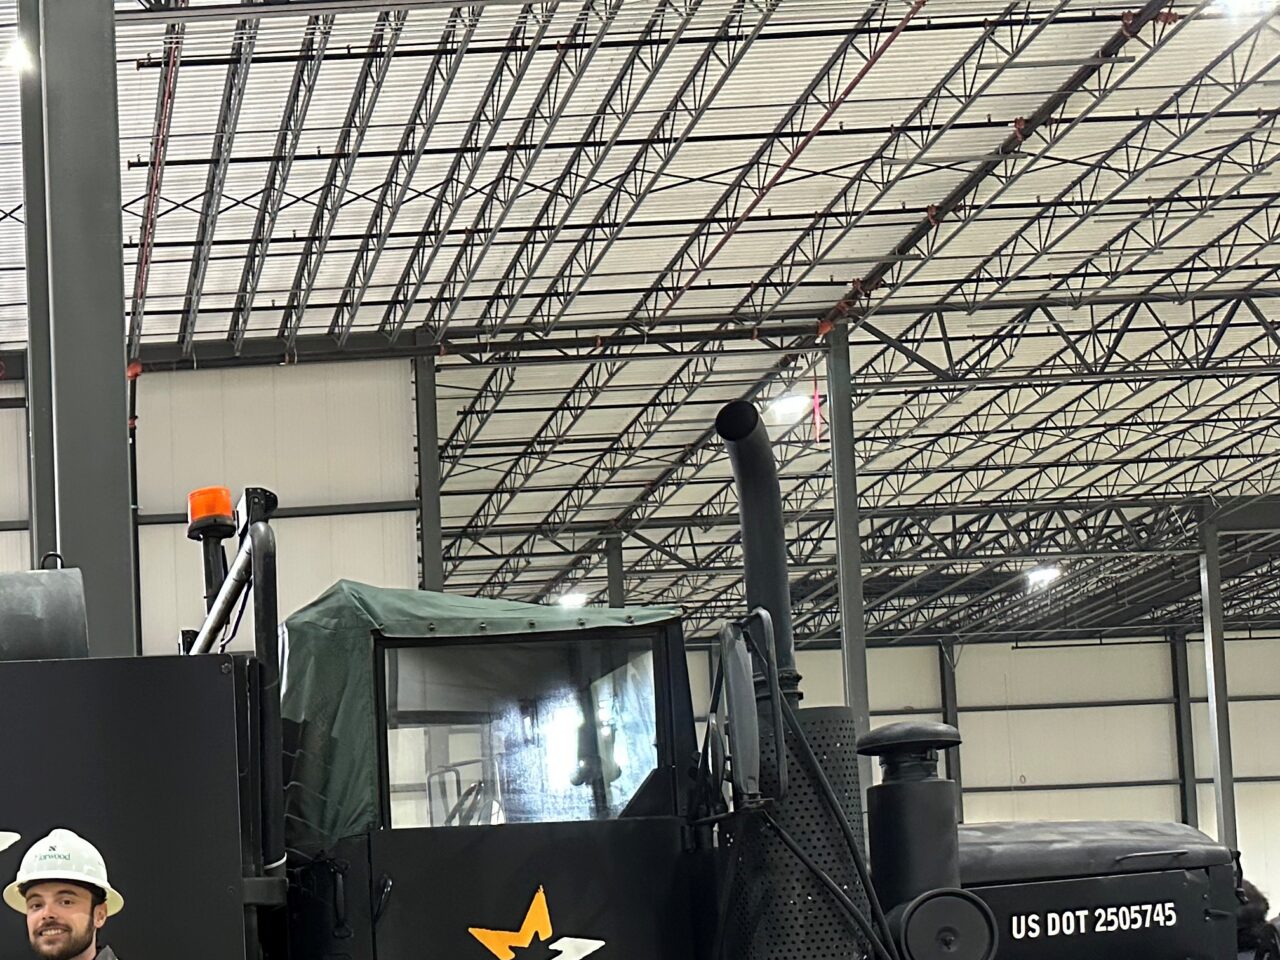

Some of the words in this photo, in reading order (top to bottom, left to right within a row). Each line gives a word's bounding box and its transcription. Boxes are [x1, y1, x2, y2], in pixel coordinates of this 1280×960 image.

[38, 853, 71, 861] orwood
[1012, 914, 1041, 939] US
[1047, 910, 1089, 936] DOT
[1094, 902, 1177, 932] 2505745
